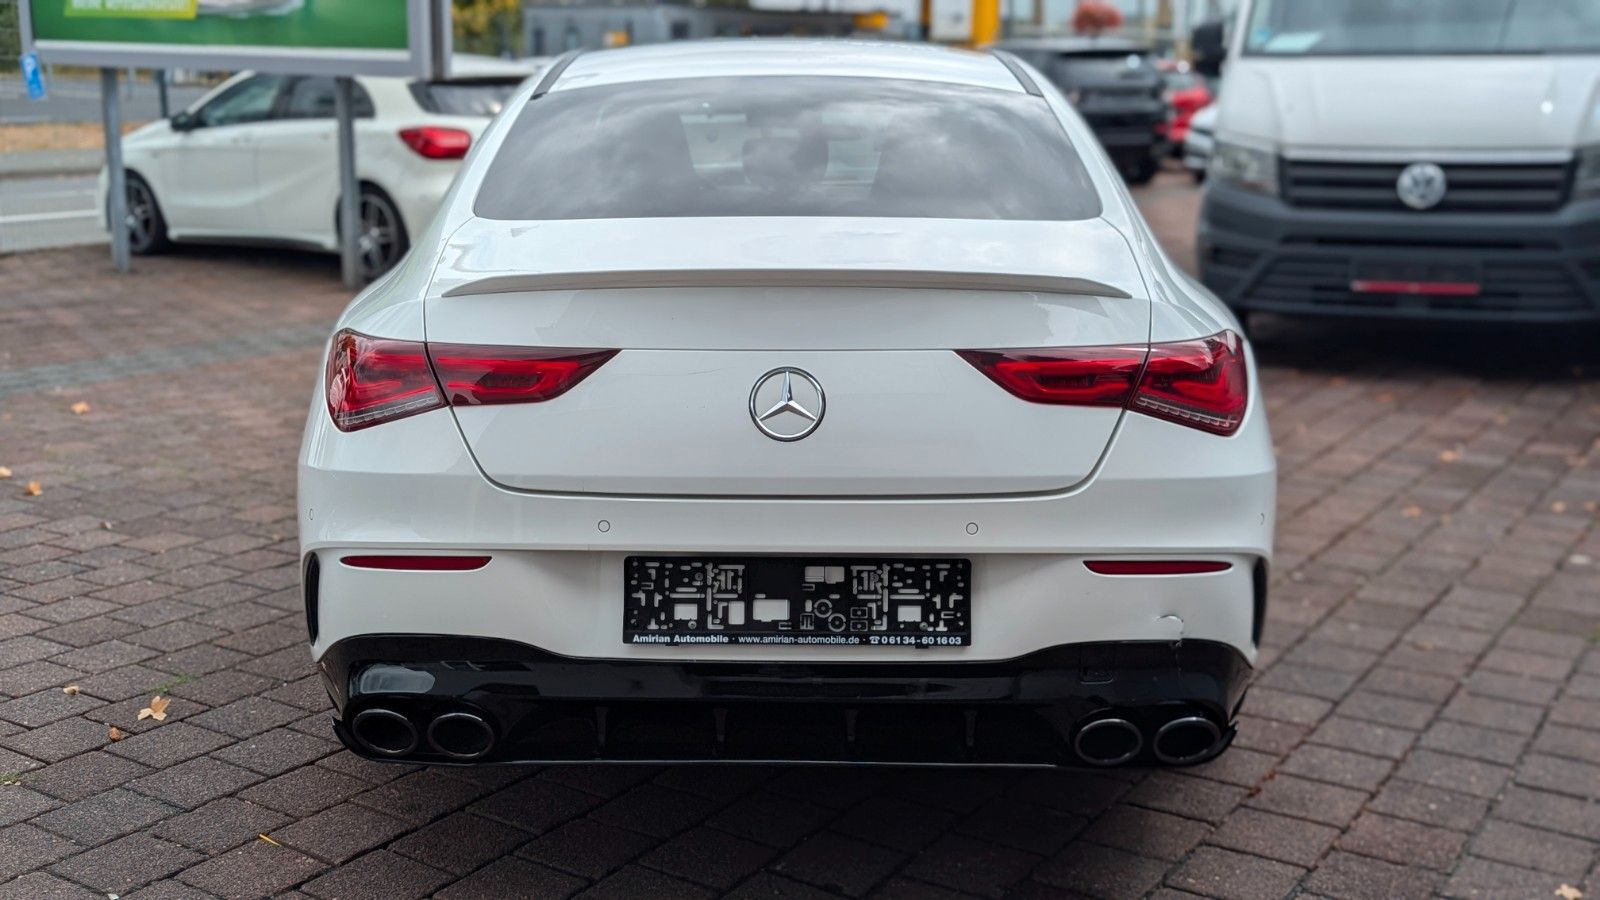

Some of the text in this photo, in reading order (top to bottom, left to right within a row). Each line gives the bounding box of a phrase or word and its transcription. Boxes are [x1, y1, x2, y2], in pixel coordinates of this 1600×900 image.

[633, 634, 671, 643] Amirian
[673, 634, 729, 643] Automobile
[738, 635, 860, 645] www.amirian-automobile.de
